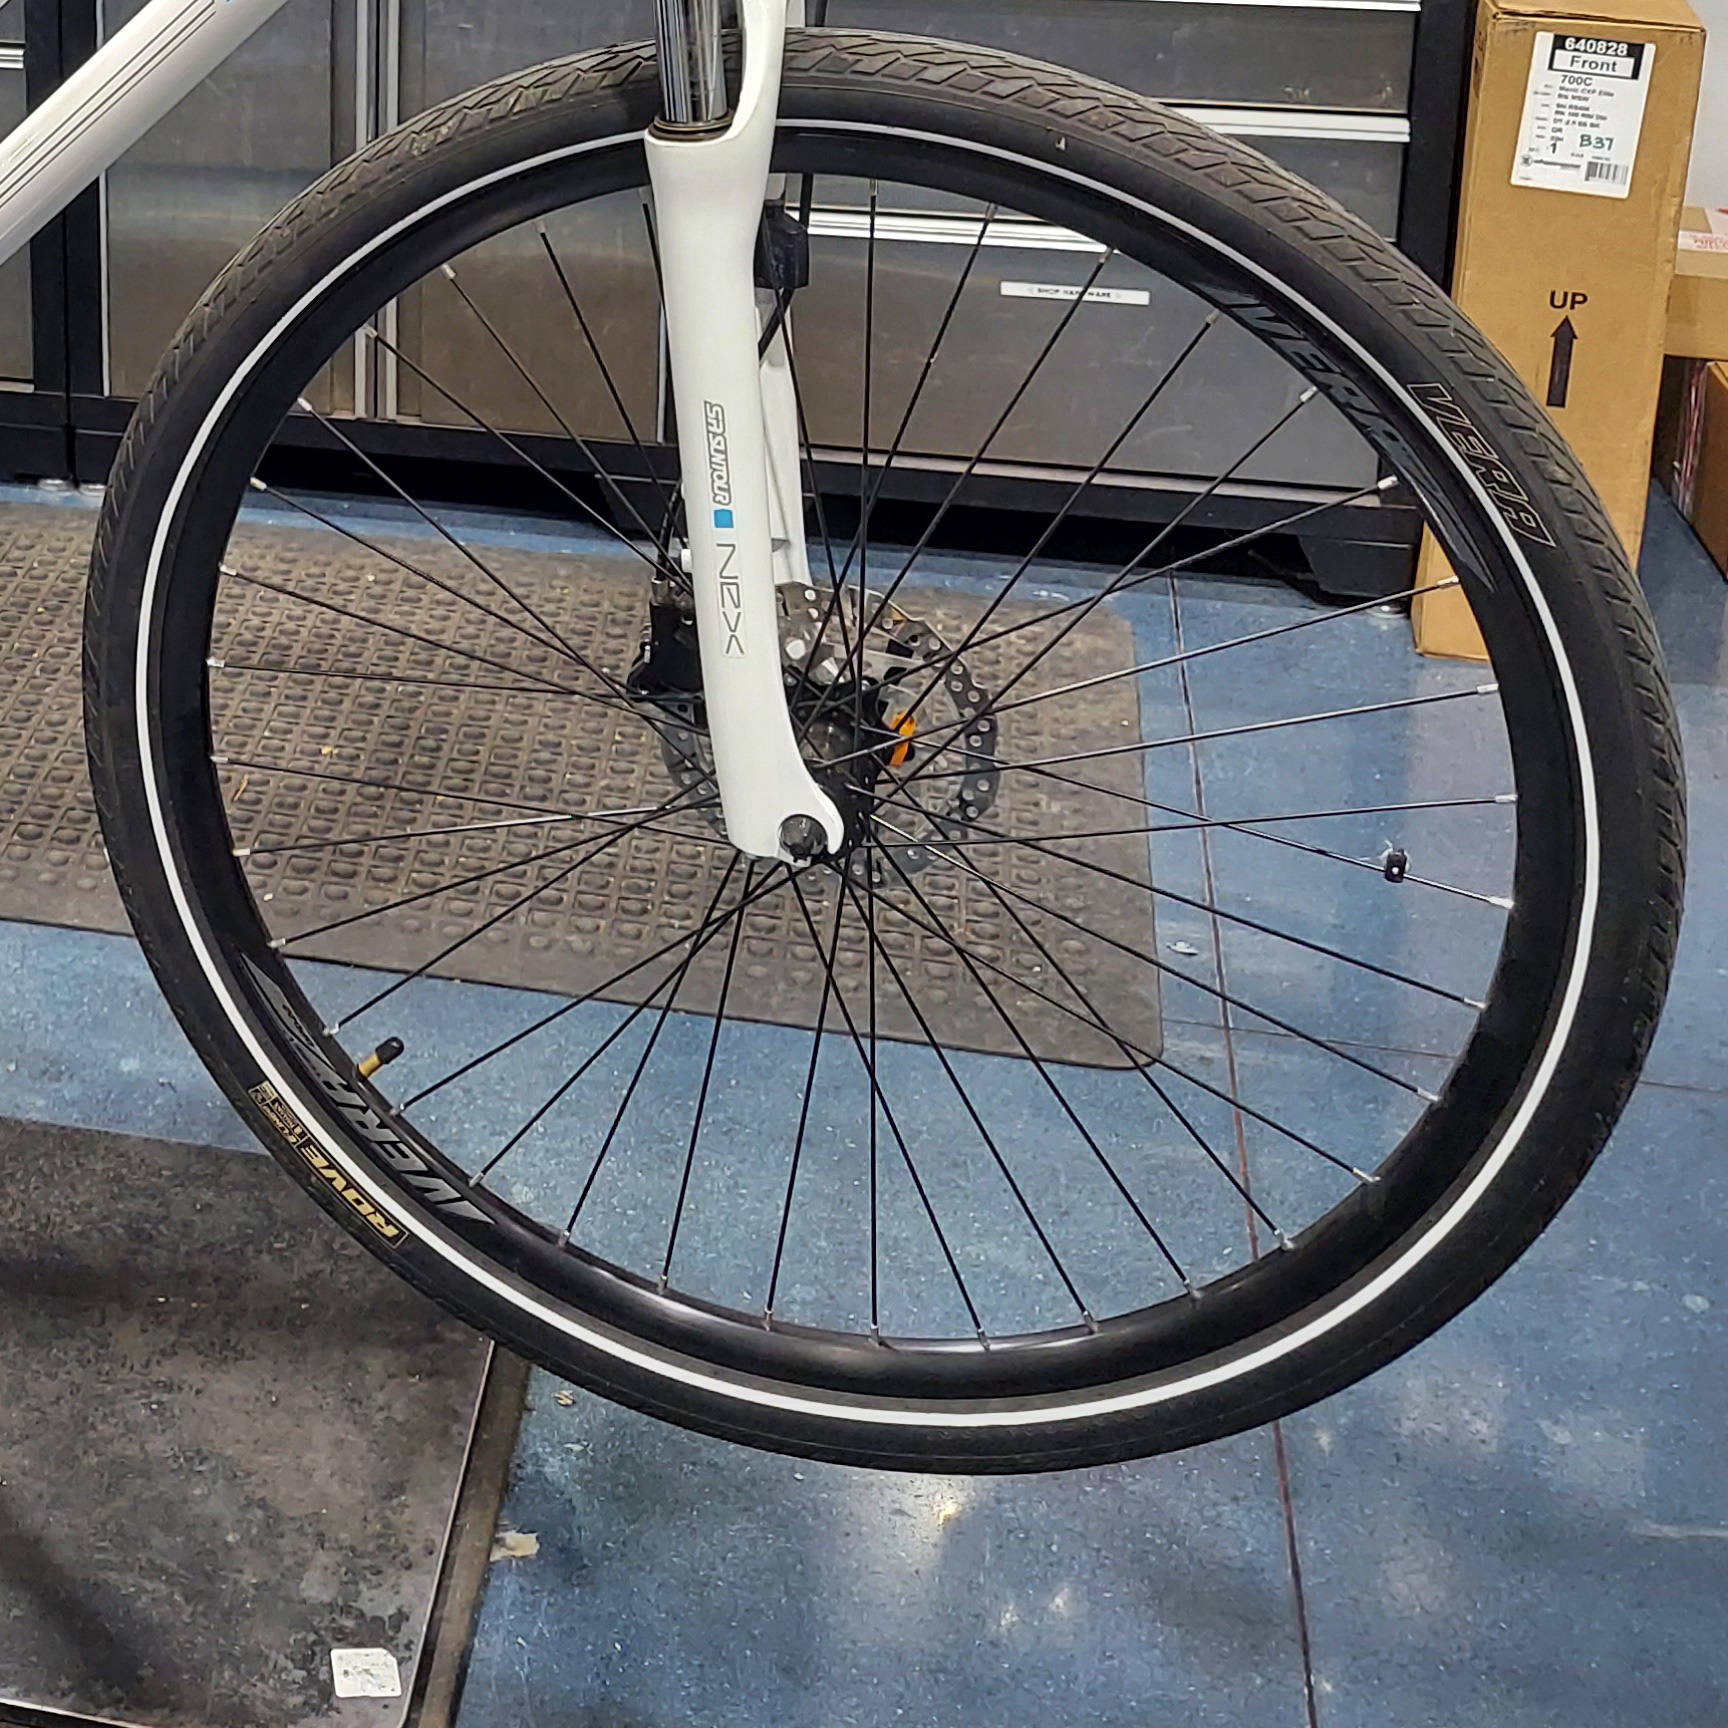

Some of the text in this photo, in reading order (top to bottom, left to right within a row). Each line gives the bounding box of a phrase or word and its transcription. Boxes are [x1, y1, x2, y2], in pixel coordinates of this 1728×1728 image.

[1564, 36, 1628, 56] 640828
[1569, 55, 1618, 72] Front
[1560, 74, 1593, 87] 700C
[1579, 133, 1614, 152] B37
[1549, 290, 1588, 310] UP
[707, 432, 731, 507] SUNTOUR
[716, 543, 745, 655] NEX
[298, 1139, 400, 1239] ROVE
